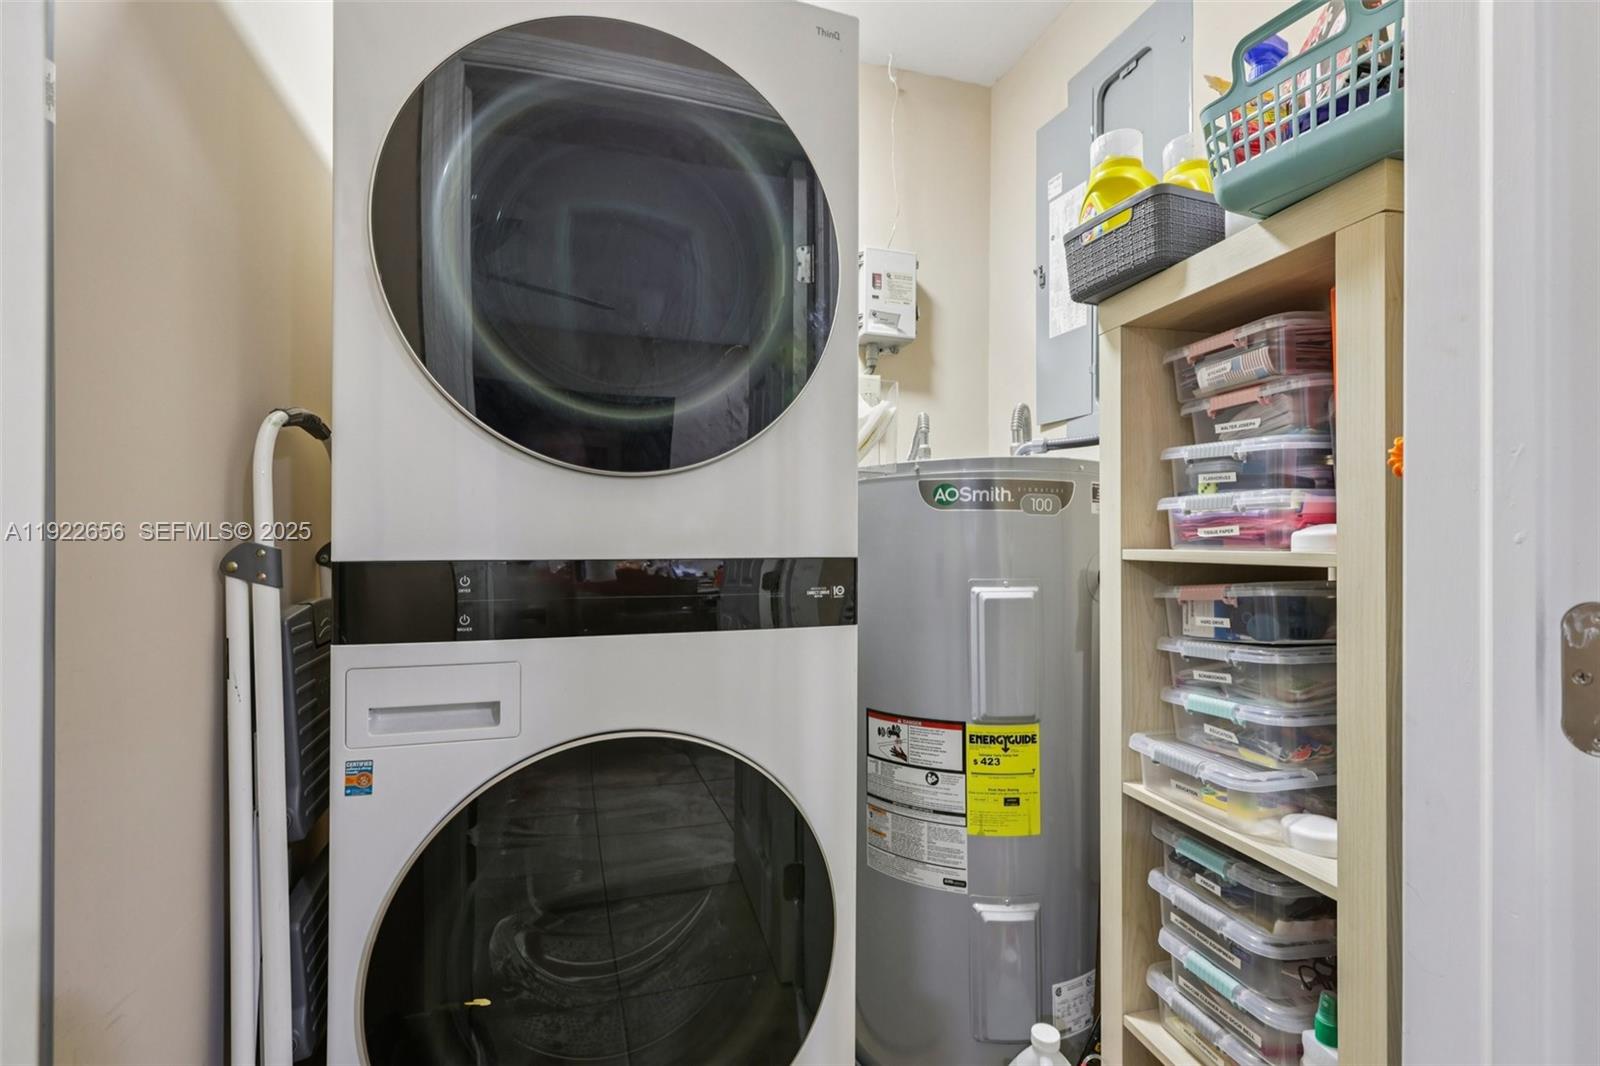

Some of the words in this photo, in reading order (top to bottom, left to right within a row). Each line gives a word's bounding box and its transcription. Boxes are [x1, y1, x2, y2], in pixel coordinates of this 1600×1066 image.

[815, 25, 841, 41] ThinQ
[1031, 498, 1053, 512] 100
[1209, 727, 1233, 740] EDUCATION
[980, 757, 1001, 767] 423
[1209, 940, 1236, 962] EQUIPMENT
[1200, 993, 1219, 1012] CLEANER
[1242, 1026, 1256, 1041] BELL
